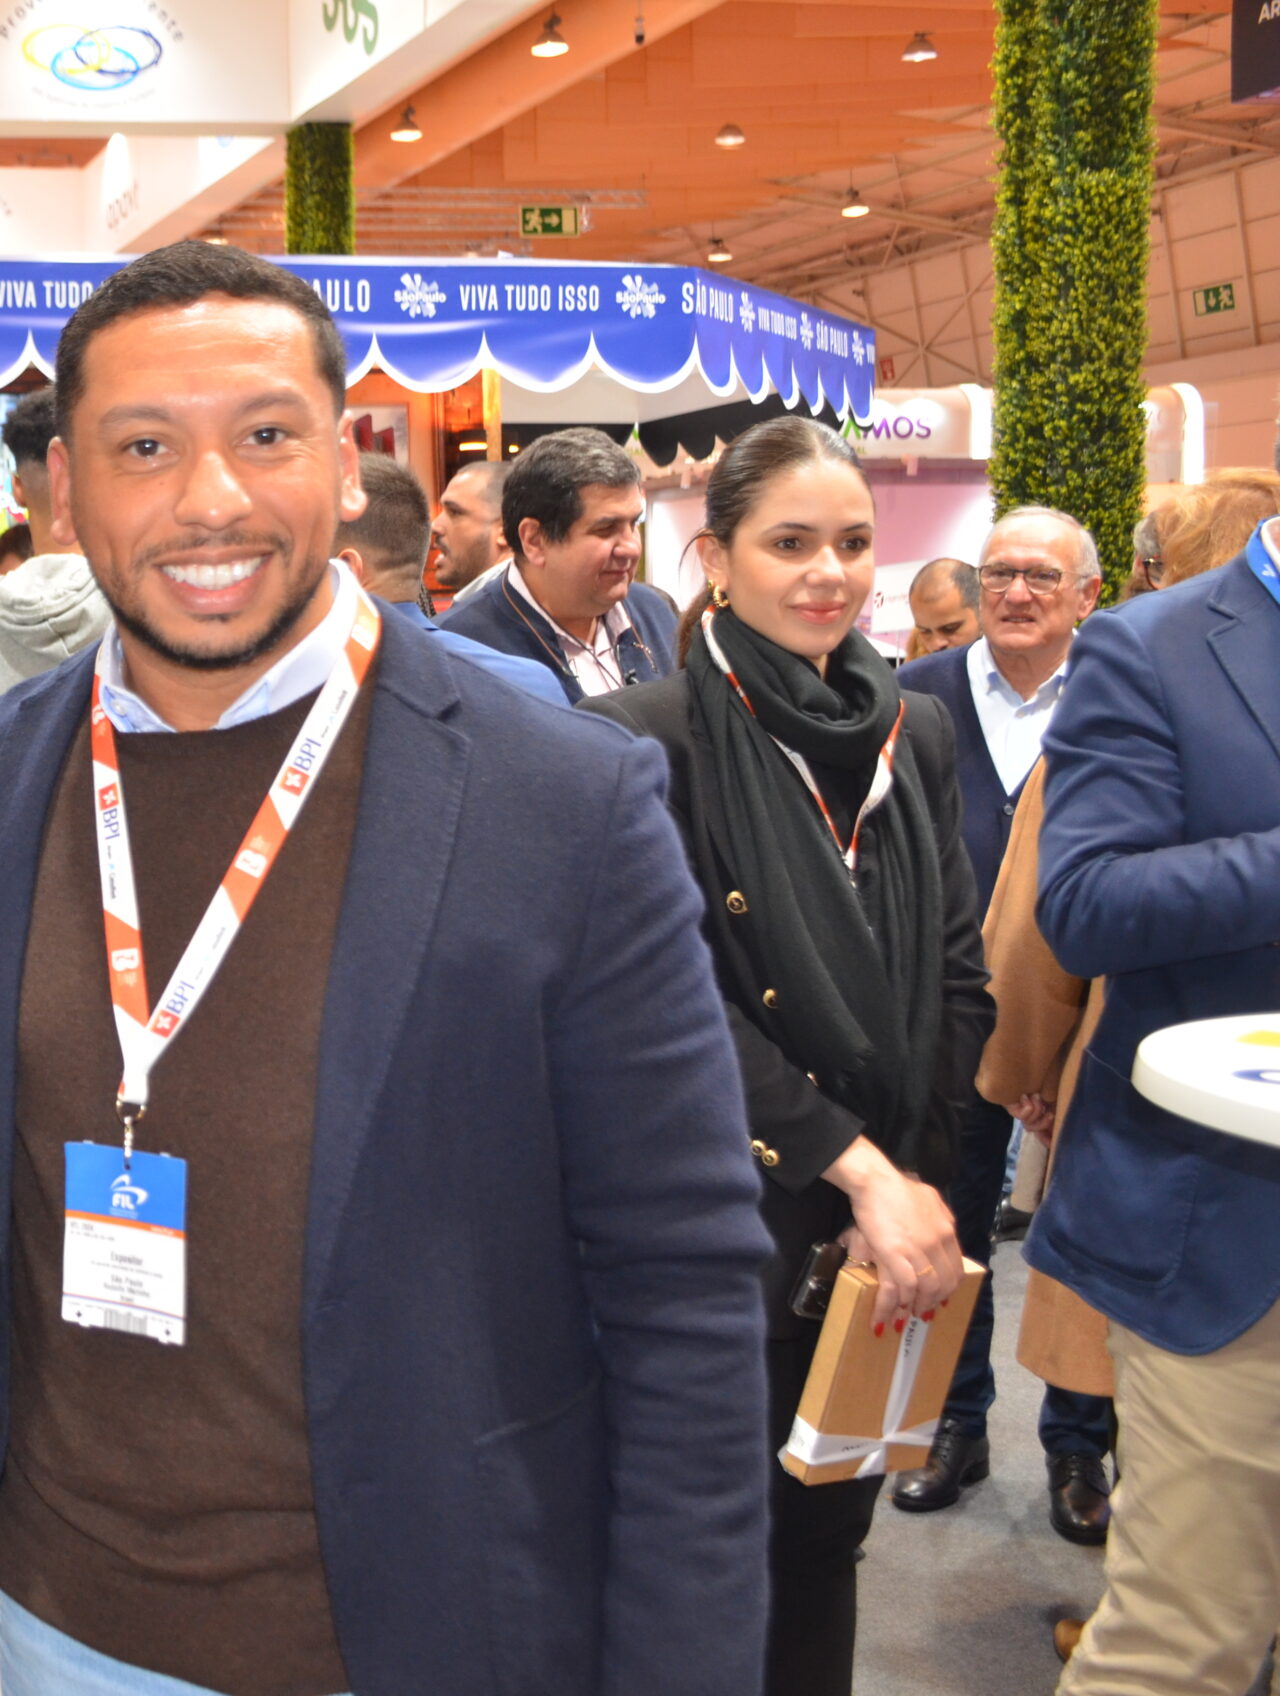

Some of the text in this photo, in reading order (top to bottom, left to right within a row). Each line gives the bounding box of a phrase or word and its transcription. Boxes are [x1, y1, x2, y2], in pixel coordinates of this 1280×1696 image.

[43, 281, 94, 309] TUDO
[312, 278, 371, 313] AULO
[459, 284, 600, 311] VIVA TUDO ISSO
[681, 278, 707, 317] SÃO
[709, 287, 734, 324] PAULO
[829, 326, 848, 359] PAULO
[293, 737, 322, 772] BPI
[101, 806, 121, 841] BPI
[166, 979, 195, 1015] BPI
[111, 1192, 137, 1211] FIL
